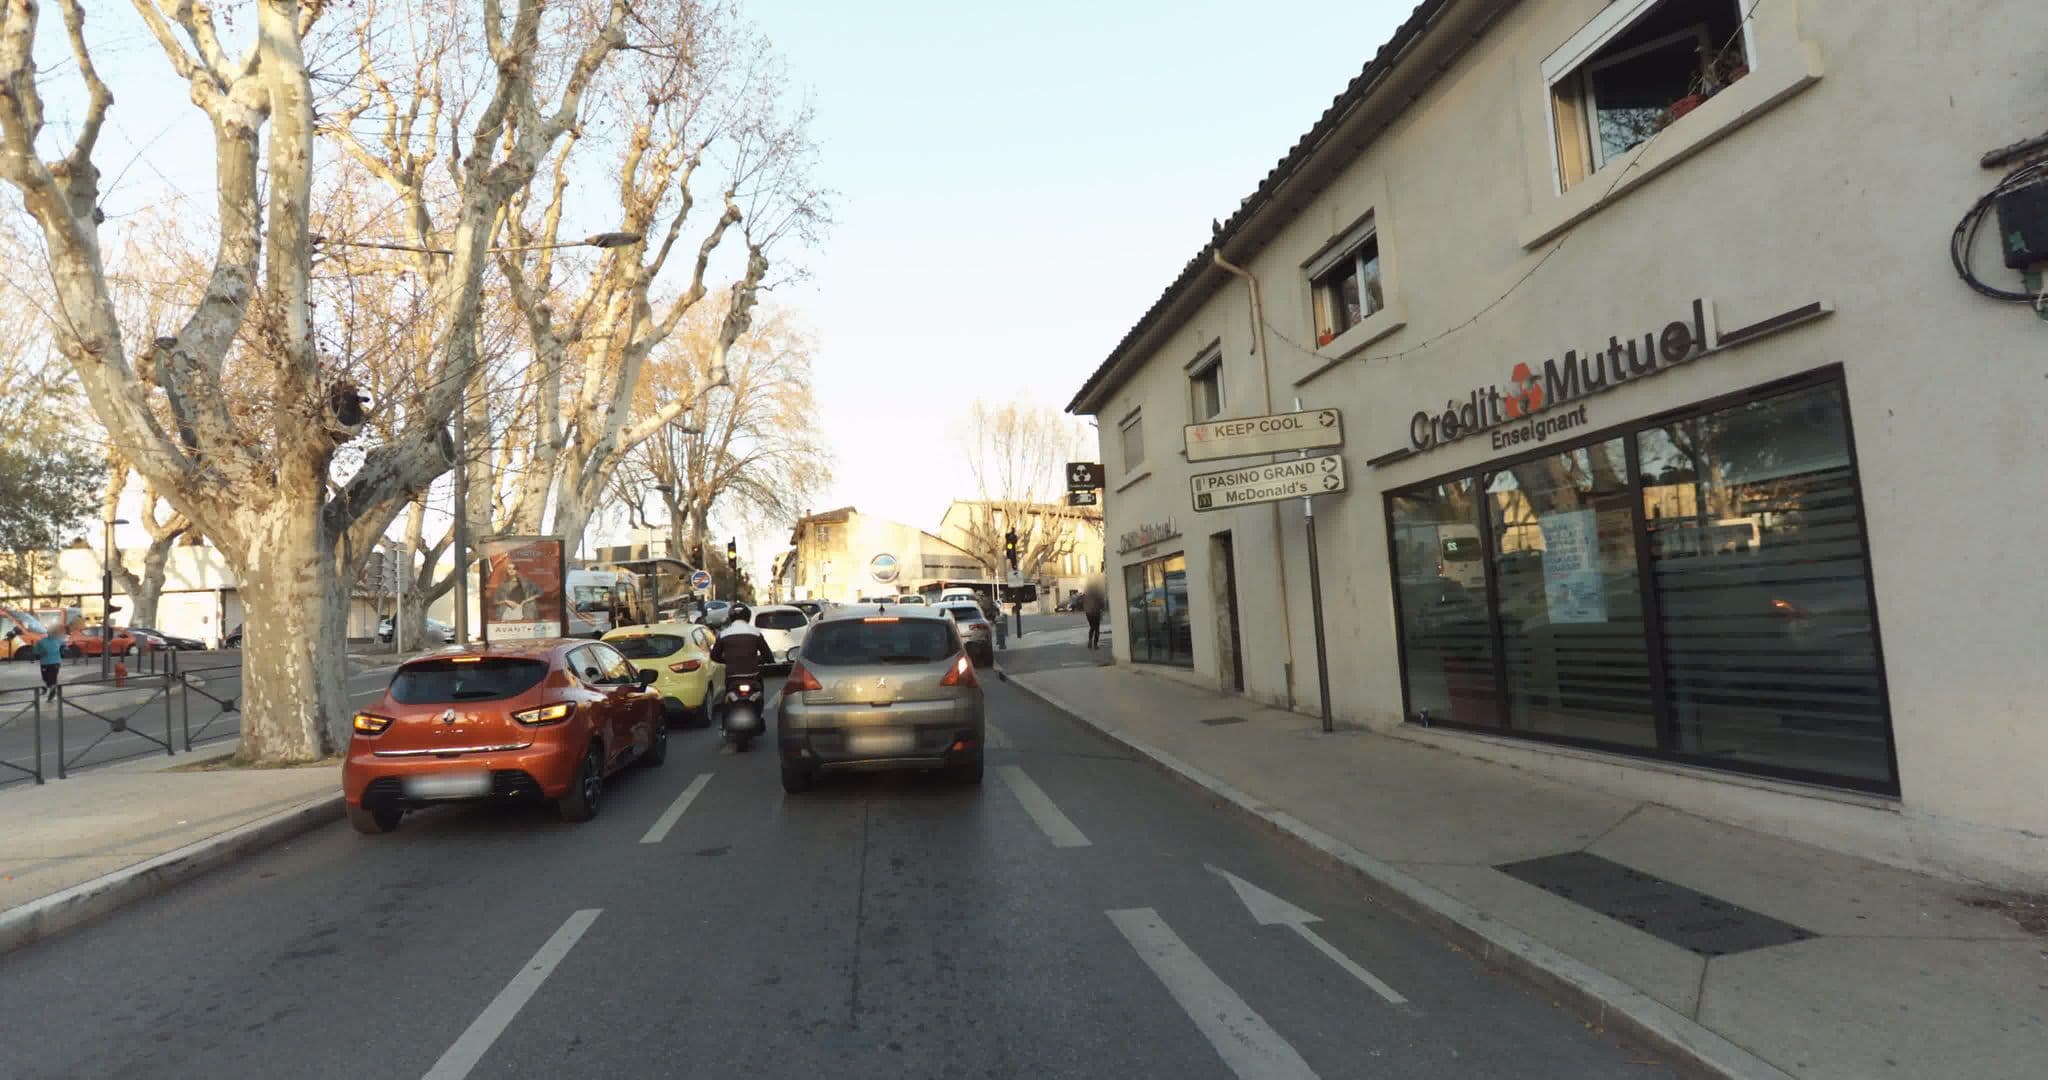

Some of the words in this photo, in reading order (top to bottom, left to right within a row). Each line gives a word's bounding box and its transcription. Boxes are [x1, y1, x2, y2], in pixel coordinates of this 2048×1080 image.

[1410, 384, 1503, 451] Crédit
[1543, 297, 1709, 405] Mutuel
[1215, 422, 1255, 438] KEEP
[1259, 417, 1303, 432] COOL
[1491, 404, 1588, 450] Enseignant
[1208, 470, 1260, 489] PASINO
[1264, 462, 1316, 480] GRAND
[1226, 481, 1308, 503] McDonald's
